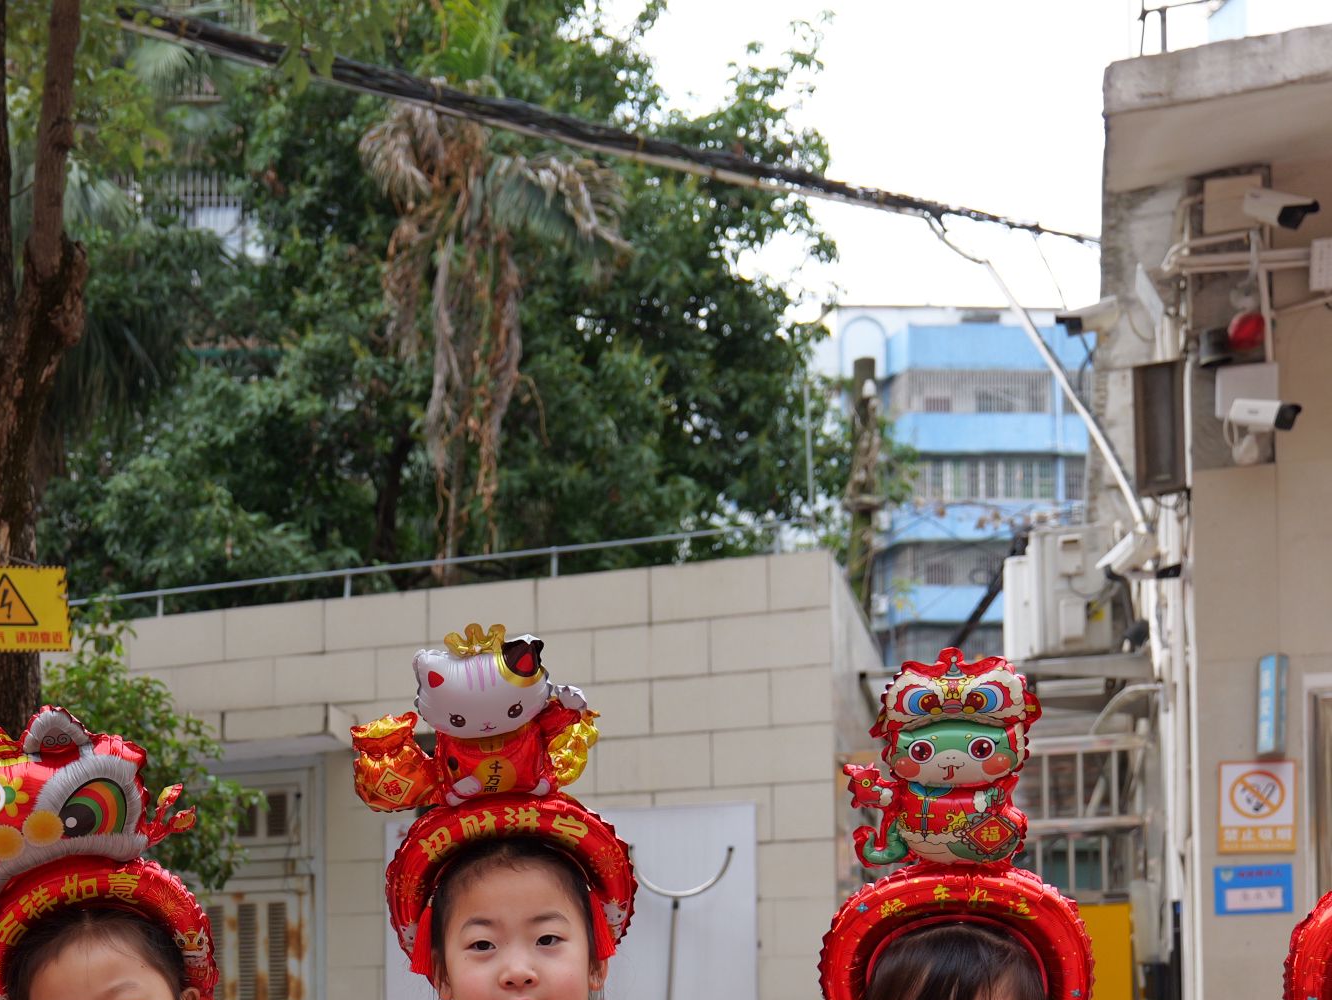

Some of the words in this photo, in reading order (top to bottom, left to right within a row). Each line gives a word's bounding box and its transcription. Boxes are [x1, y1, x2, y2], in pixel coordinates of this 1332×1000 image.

[16, 631, 63, 644] 请勿靠近
[382, 778, 403, 797] 福
[418, 806, 589, 864] 招财进宝
[980, 826, 1001, 843] 福
[1224, 827, 1292, 842] 禁止吸烟
